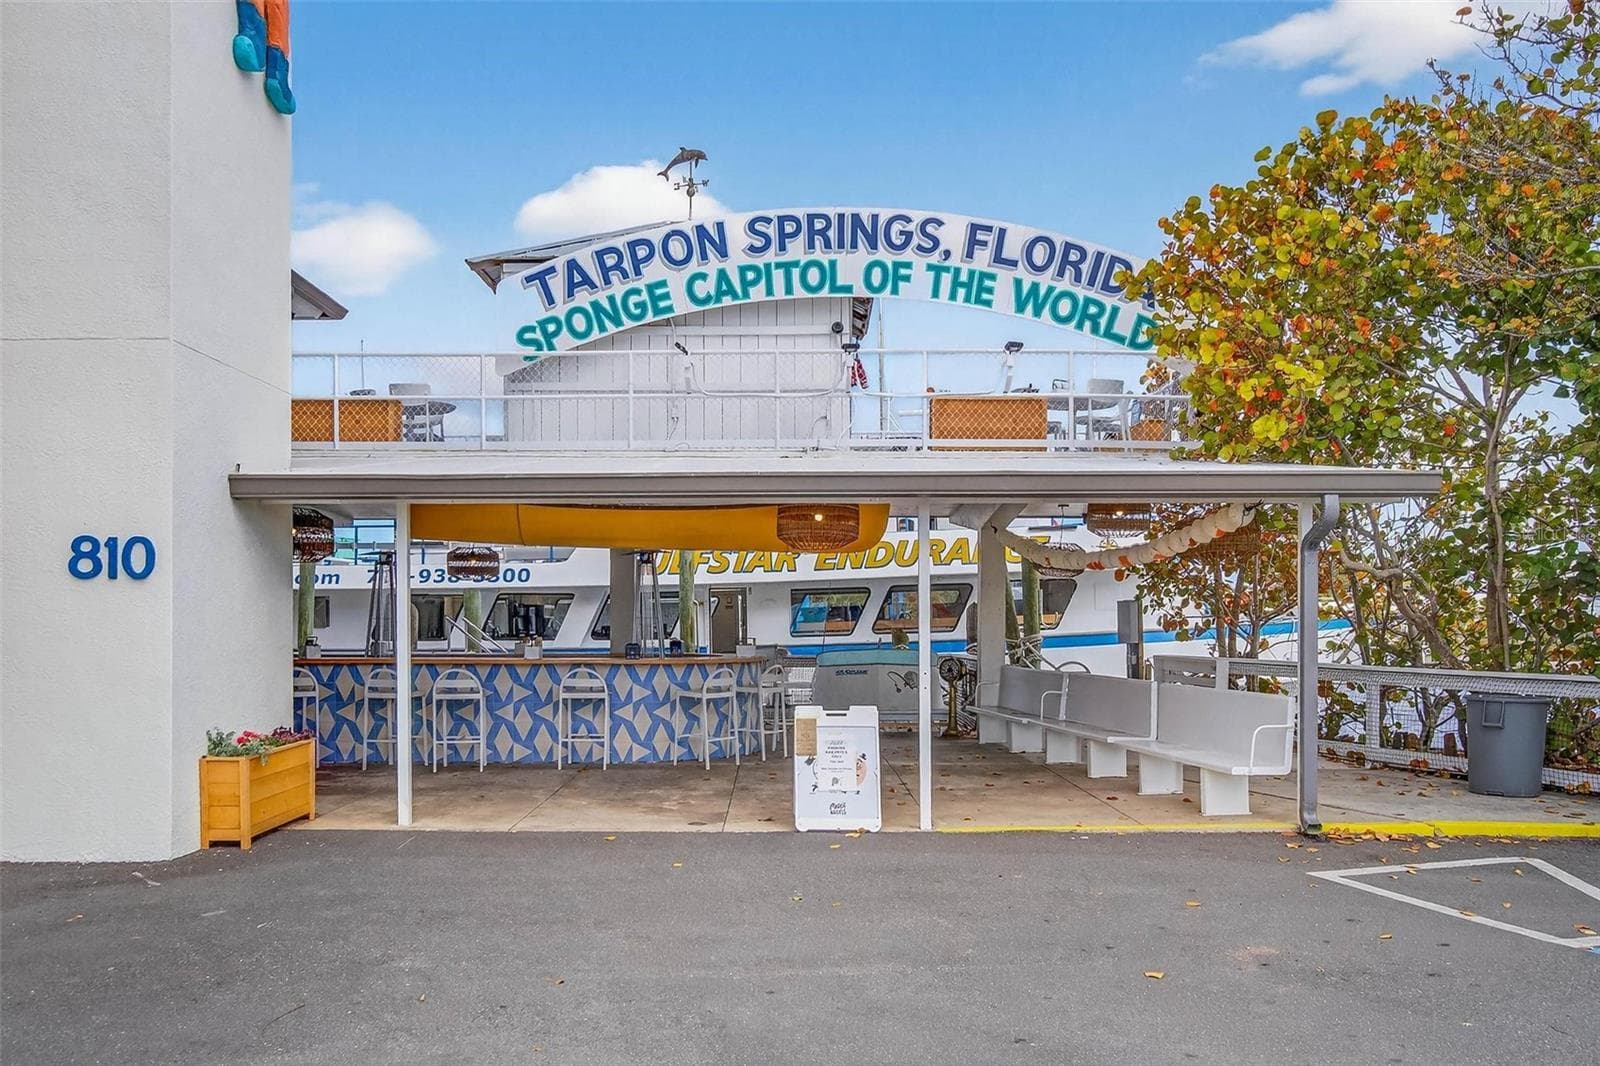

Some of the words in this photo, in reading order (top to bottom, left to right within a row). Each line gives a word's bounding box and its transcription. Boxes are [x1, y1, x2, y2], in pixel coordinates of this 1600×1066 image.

[523, 220, 730, 309] TARPON
[744, 212, 953, 262] SPRINGS,
[515, 278, 675, 362] SPONGE
[685, 258, 855, 309] CAPITOL
[862, 259, 914, 297] OF
[924, 262, 998, 310] THE
[1012, 277, 1160, 351] WORLD
[67, 534, 156, 580] 810
[656, 549, 801, 576] ULFSTAR
[814, 535, 1050, 571] ENDURA
